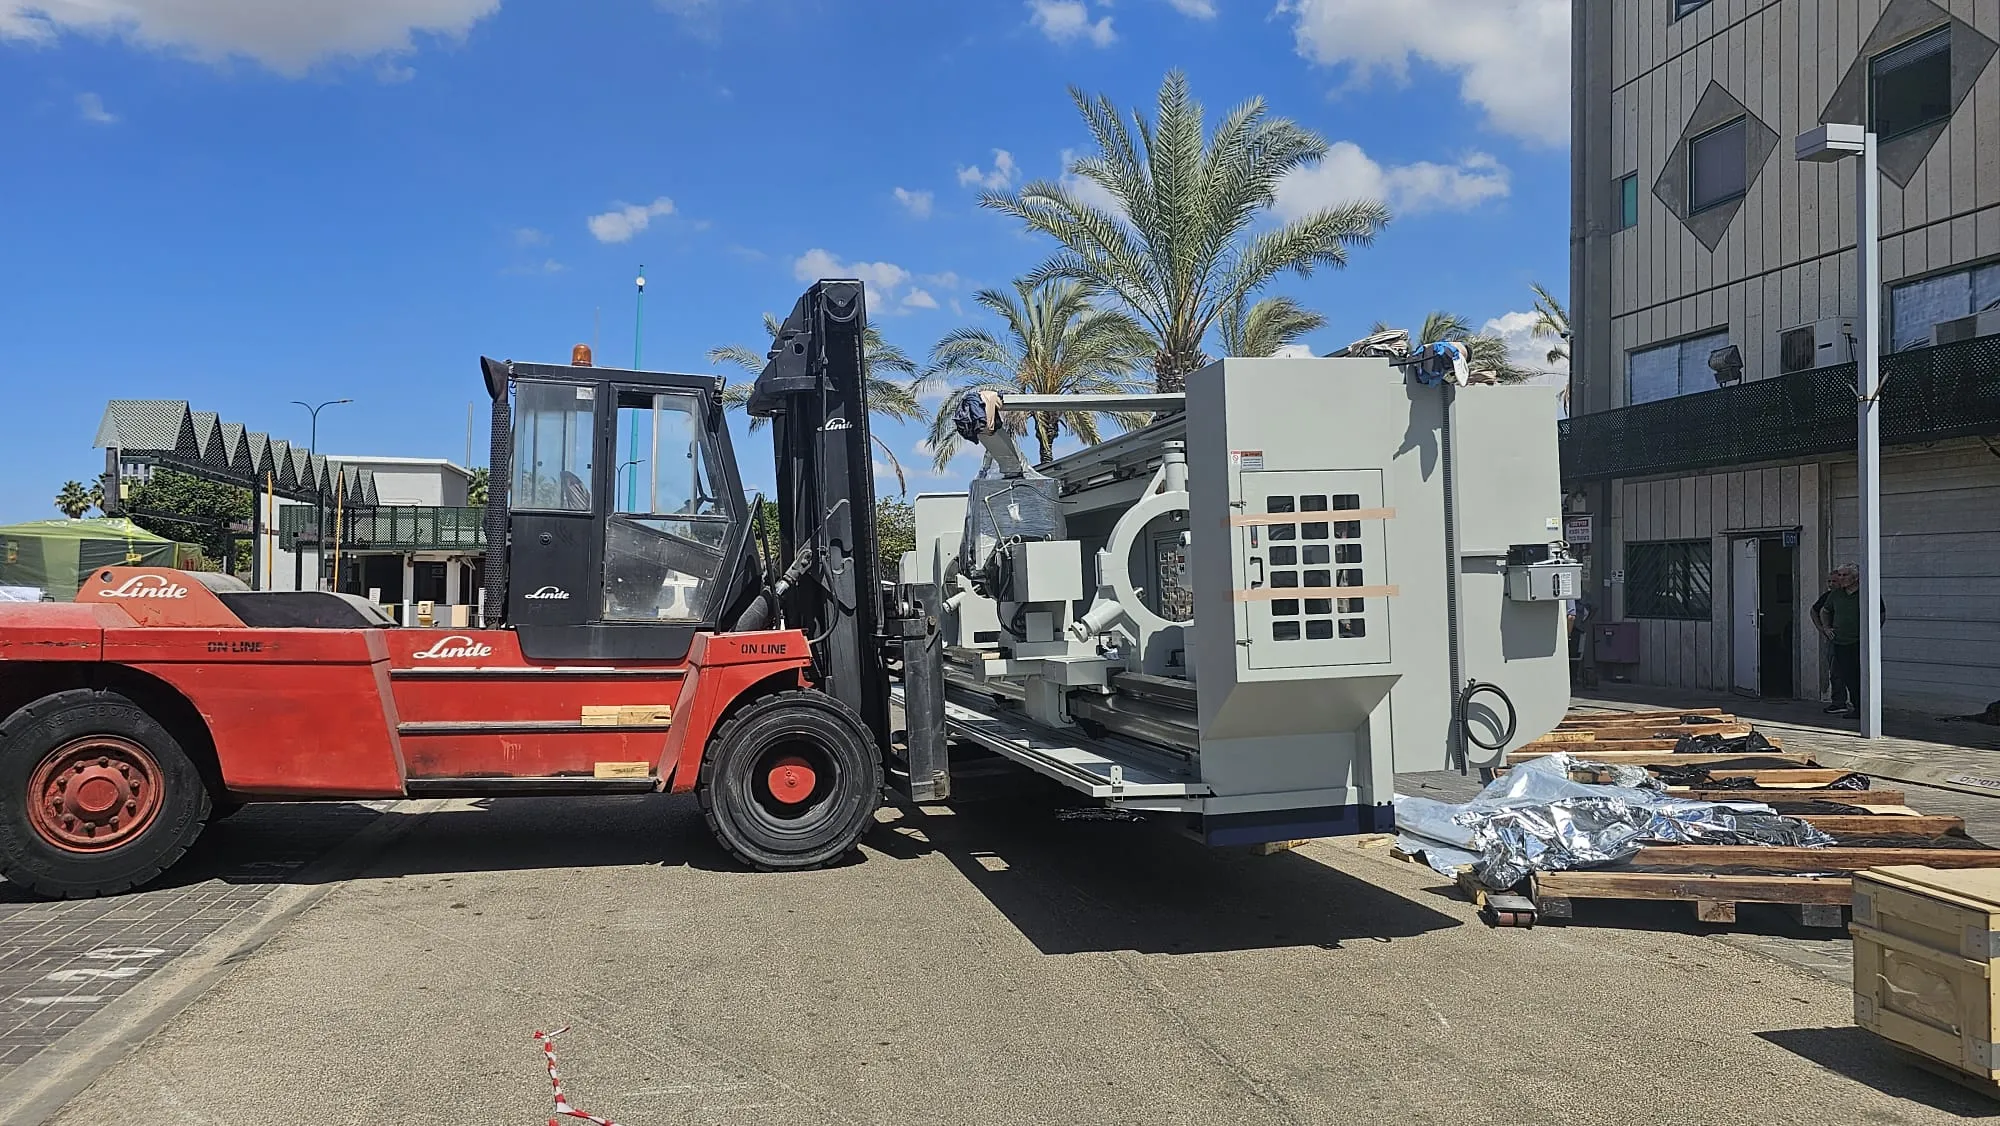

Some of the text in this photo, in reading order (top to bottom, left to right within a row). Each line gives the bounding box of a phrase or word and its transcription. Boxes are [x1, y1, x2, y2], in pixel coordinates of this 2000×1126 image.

[98, 574, 188, 599] Linde
[524, 585, 570, 600] Linde
[208, 641, 264, 653] ON LINE
[412, 635, 493, 659] Linde
[741, 643, 786, 654] ON LINE
